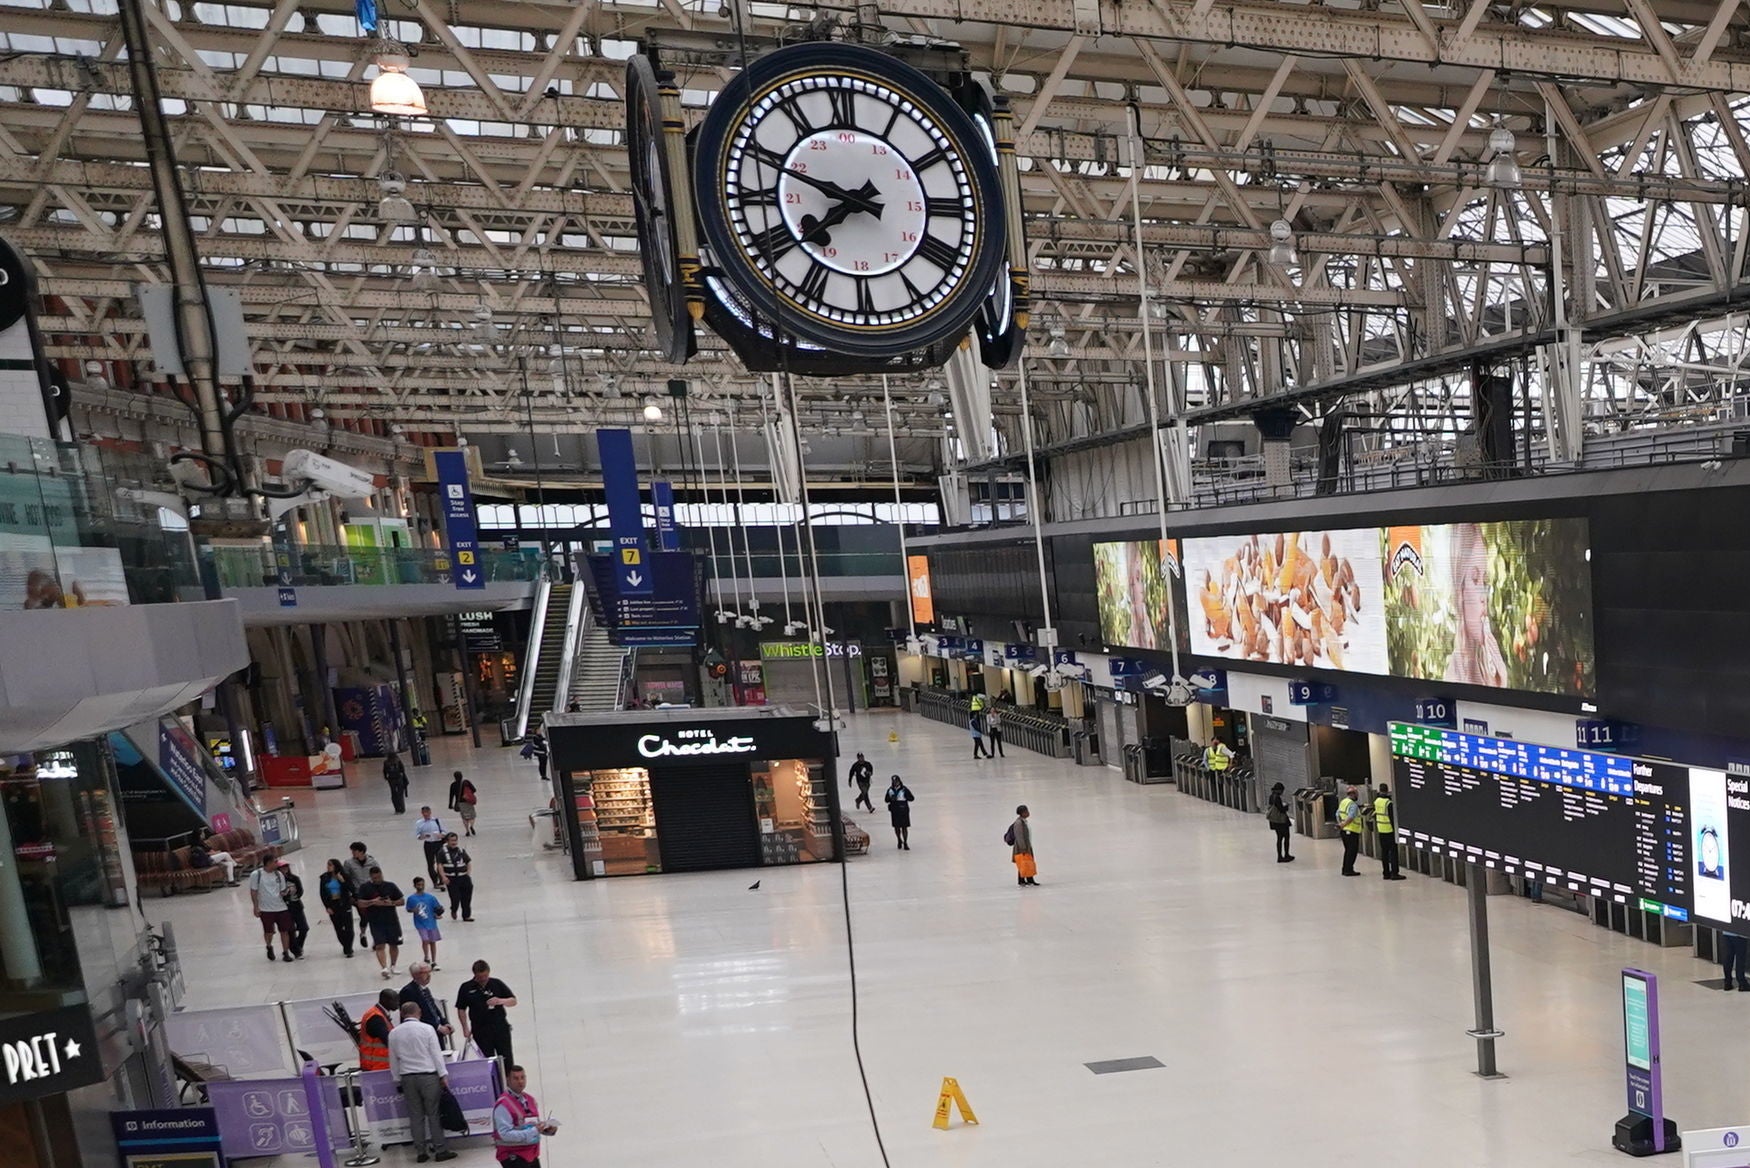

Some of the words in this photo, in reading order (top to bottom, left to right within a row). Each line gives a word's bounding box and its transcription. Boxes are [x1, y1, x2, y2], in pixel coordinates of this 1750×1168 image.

[839, 133, 855, 144] 00
[810, 140, 827, 152] 23
[872, 145, 887, 156] 13
[791, 162, 808, 174] 22
[895, 169, 911, 181] 14
[786, 193, 802, 204] 21
[908, 201, 922, 212] 15
[901, 231, 917, 242] 16
[821, 247, 837, 258] 19
[883, 252, 898, 263] 17
[854, 261, 869, 272] 18
[462, 553, 470, 563] 2
[627, 551, 635, 562] 7
[459, 612, 492, 620] LUSH
[942, 638, 948, 646] 3
[972, 642, 978, 650] 4
[1011, 647, 1017, 656] 5
[1061, 654, 1068, 663] 6
[1118, 662, 1125, 672] 7
[1301, 687, 1310, 700] 9
[1427, 704, 1445, 719] 10
[678, 729, 713, 738] HOTEL
[1591, 727, 1612, 743] 11
[1633, 764, 1652, 777] Further
[1634, 780, 1663, 795] Departures
[1728, 779, 1748, 794] Special
[1728, 797, 1750, 811] Notices
[2, 1032, 60, 1085] PRET
[369, 1095, 405, 1105] Passe
[451, 1084, 488, 1095] stance
[142, 1119, 206, 1130] Information
